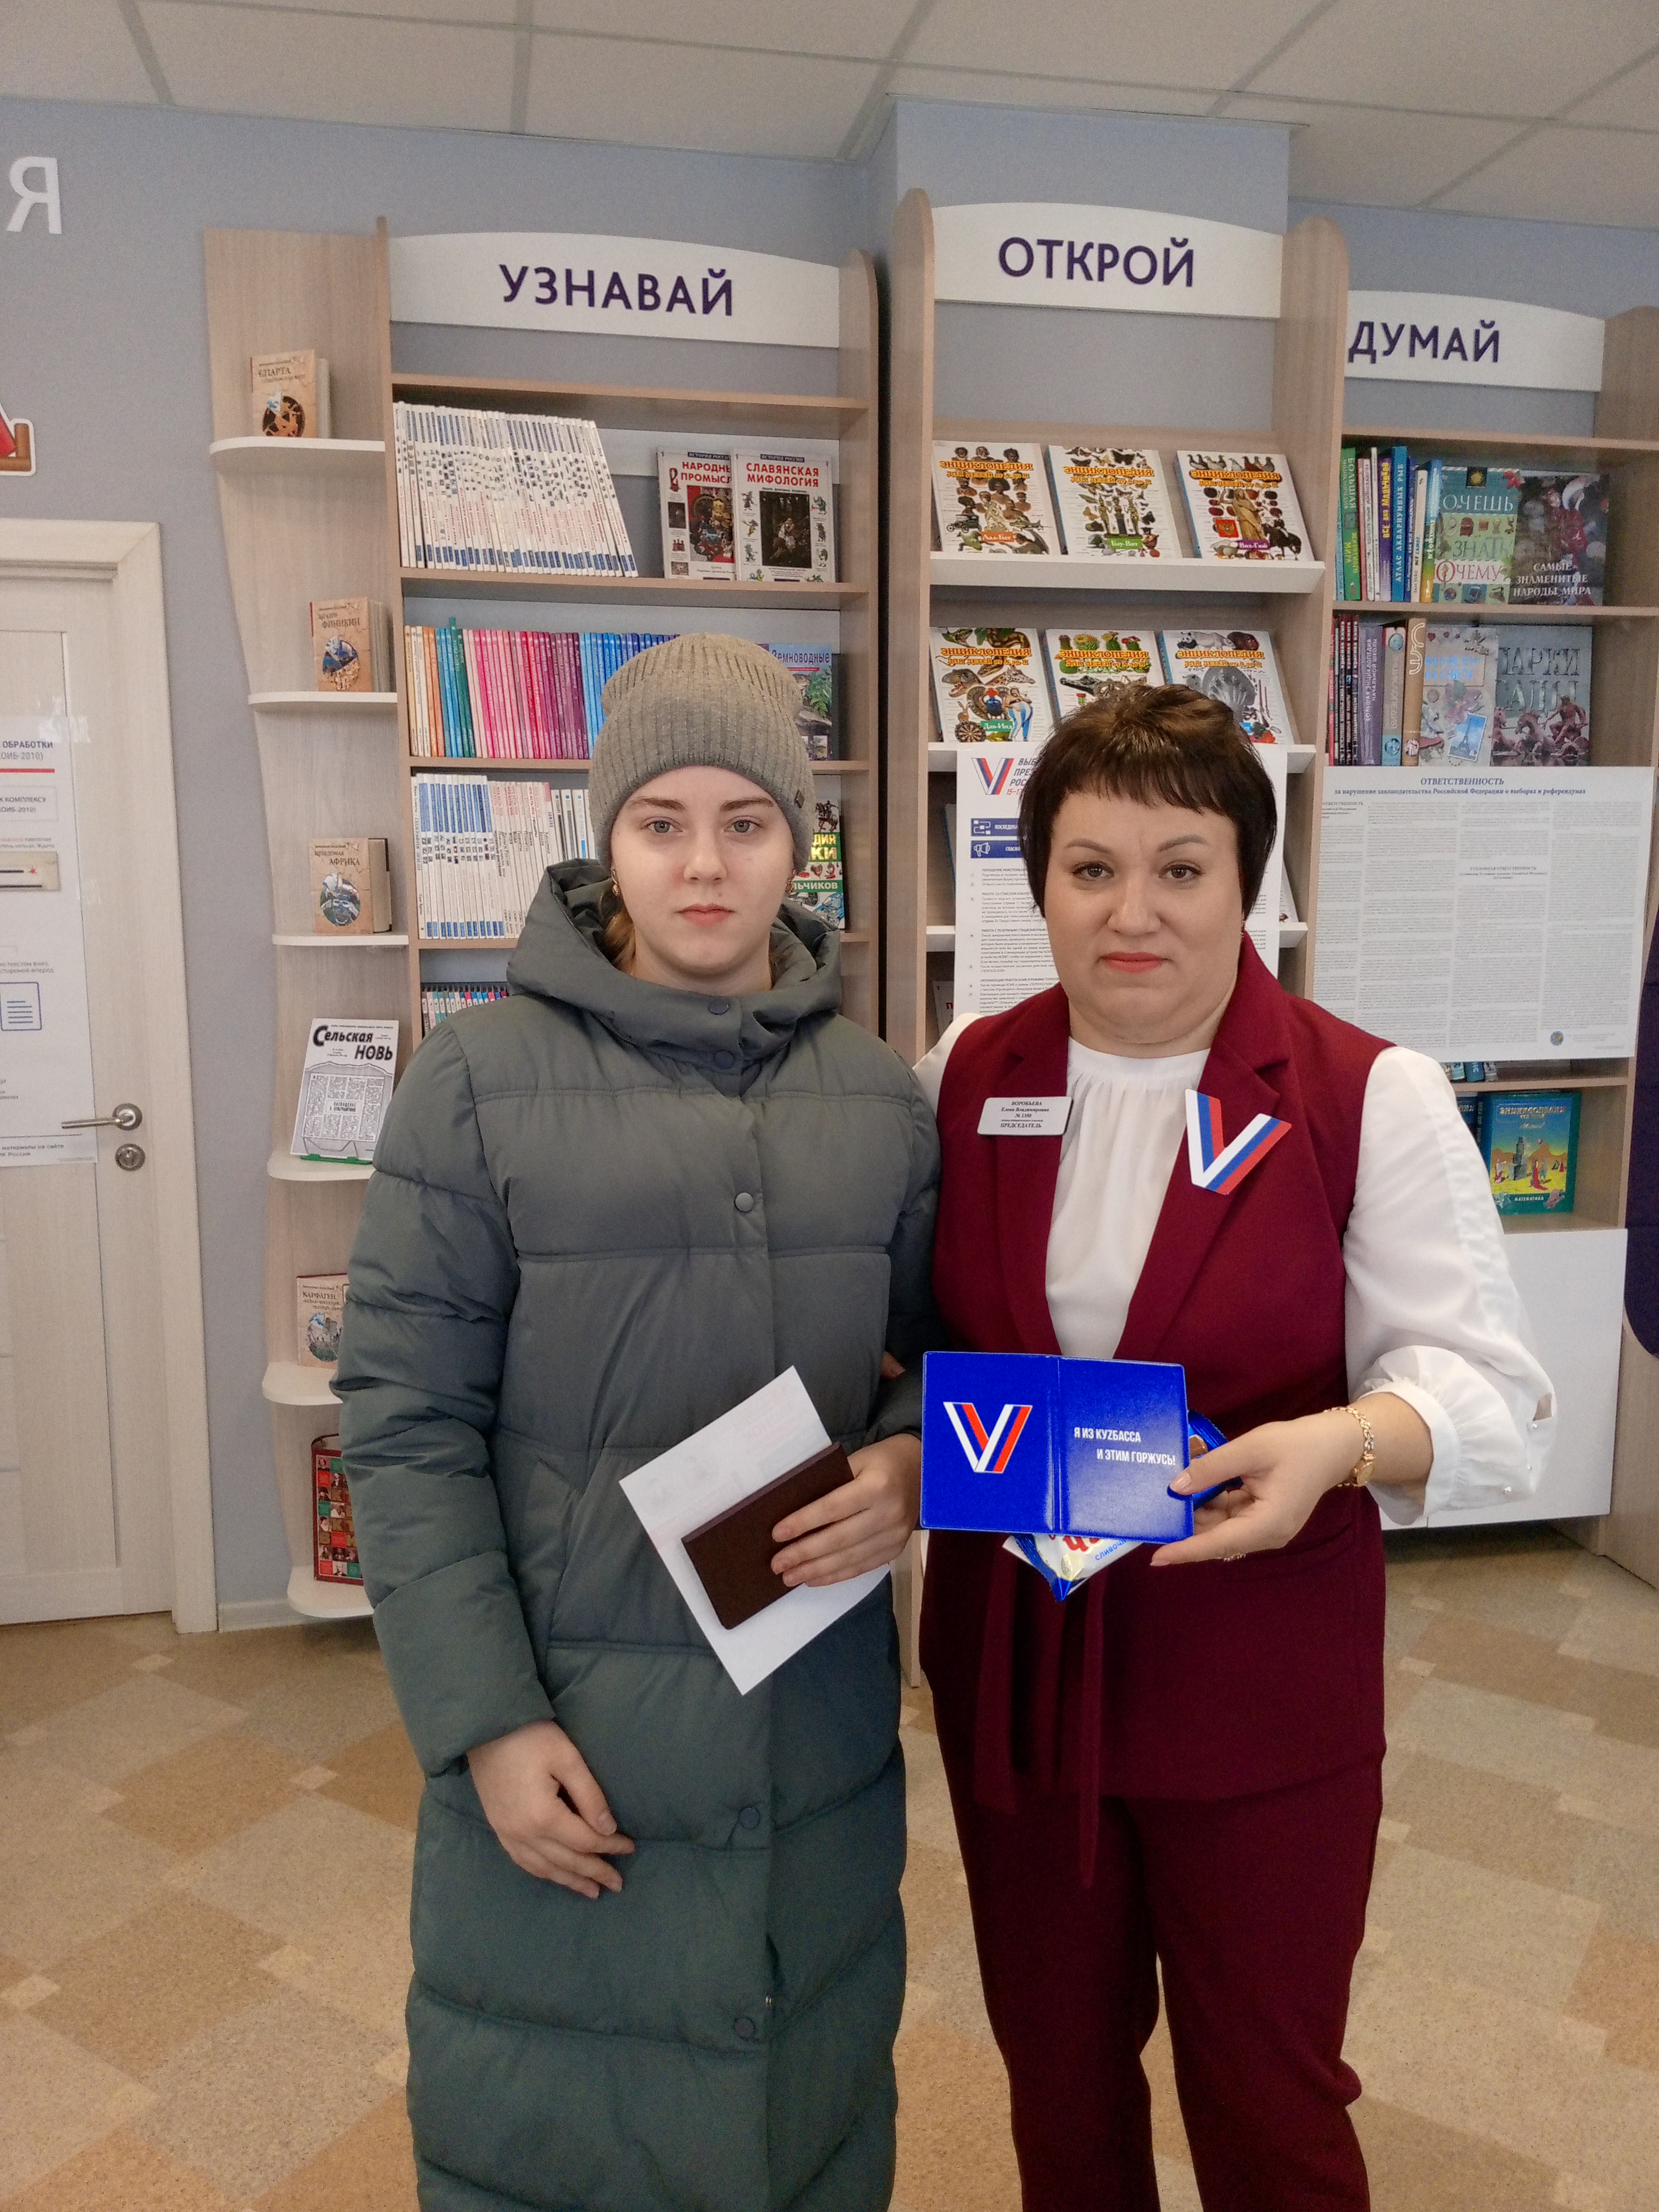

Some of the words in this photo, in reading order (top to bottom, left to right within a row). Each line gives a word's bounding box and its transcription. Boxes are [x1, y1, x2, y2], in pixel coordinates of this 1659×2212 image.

[6, 156, 62, 234] Я
[999, 237, 1194, 287] ОТКРОЙ
[500, 264, 733, 316] УЗНАВАЙ
[1348, 320, 1501, 364] ДУМАЙ
[746, 463, 819, 476] СЛАВЯНСКАЯ
[940, 460, 1033, 471] ЭНЦИКЛОПЕДИЯ
[1063, 466, 1155, 476] ЭНЦИКЛОПЕДИЯ
[747, 474, 819, 487] МИФОЛОГИЯ
[1191, 470, 1280, 480] ЭНЦИКЛОПЕДИЯ
[1443, 494, 1513, 512] ОЧЕШЬ
[1436, 560, 1502, 583] ОЧЕМУ
[1534, 563, 1572, 571] САМЫЕ
[1516, 574, 1588, 584] ЗНАМЕНИТЫЕ
[1513, 586, 1560, 597] НАРОДЫ
[1562, 587, 1591, 596] МИРА
[941, 648, 1031, 657] ЭНЦИКЛОПЕДИЯ
[1060, 650, 1149, 659] ЭНЦИКЛОПЕДИЯ
[1177, 650, 1265, 659] ЭНЦИКЛОПЕДИЯ
[0, 751, 44, 761] ОИБ-2010)
[313, 1025, 373, 1047] Сельская
[355, 1045, 393, 1061] НОВЬ
[302, 1291, 337, 1300] КАРФАГЕН
[1074, 1427, 1081, 1438] Я
[1082, 1427, 1094, 1439] ИЗ
[1096, 1448, 1104, 1460] И
[1104, 1449, 1130, 1462] ЭТИМ
[1131, 1451, 1176, 1465] ГОРЖУСЬ!
